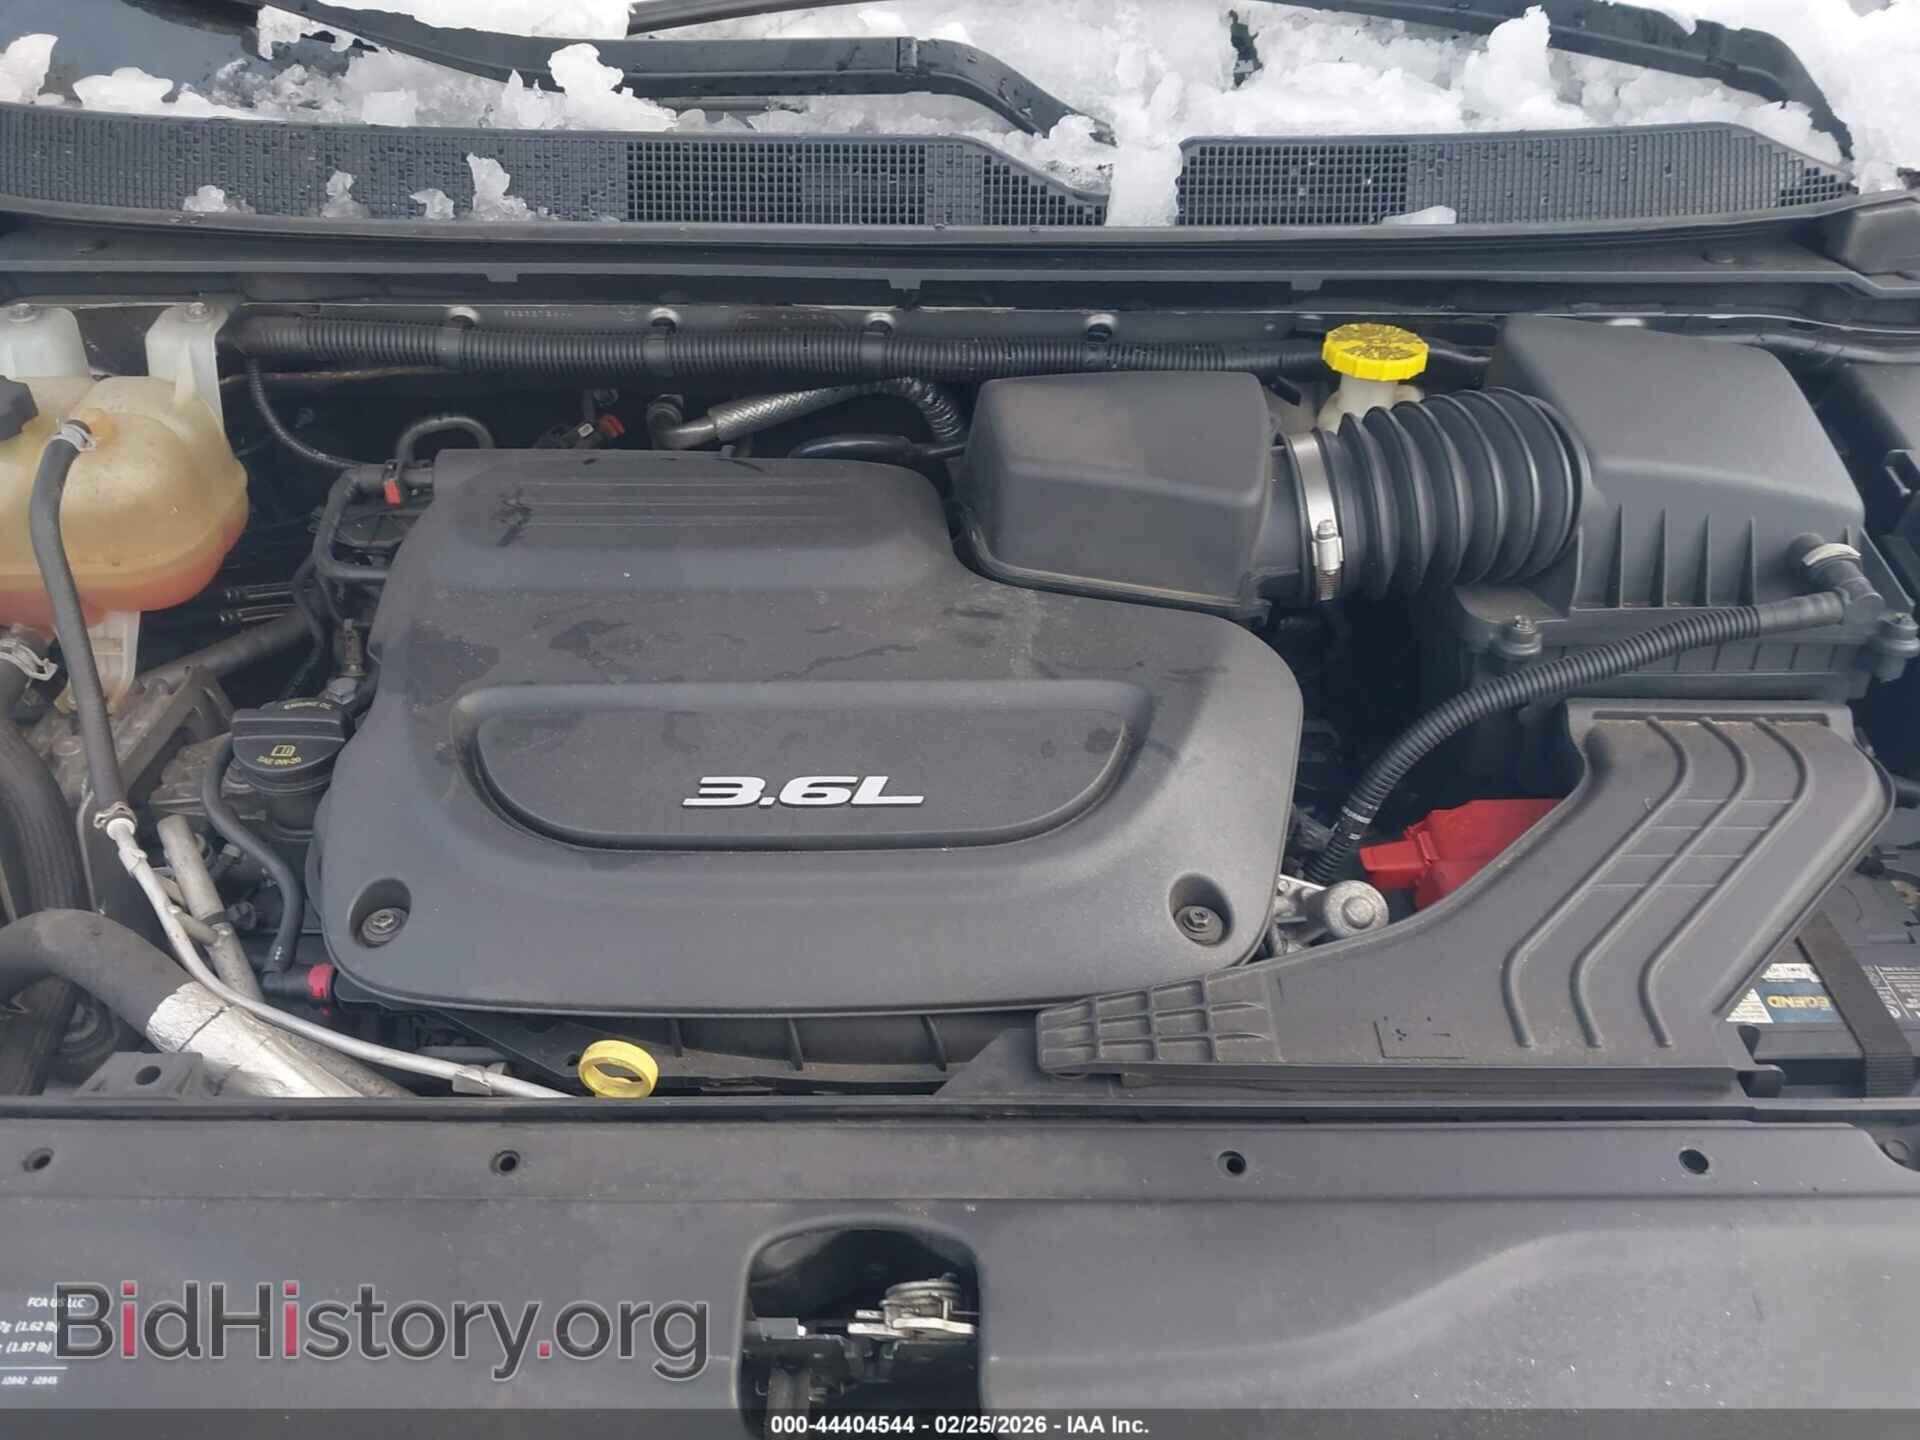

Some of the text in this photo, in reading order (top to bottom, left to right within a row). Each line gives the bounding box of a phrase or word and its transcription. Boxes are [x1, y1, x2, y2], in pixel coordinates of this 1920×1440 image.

[682, 776, 925, 807] 3.6L
[27, 1297, 87, 1308] FCA US LLC
[6, 1342, 35, 1354] (1.87
